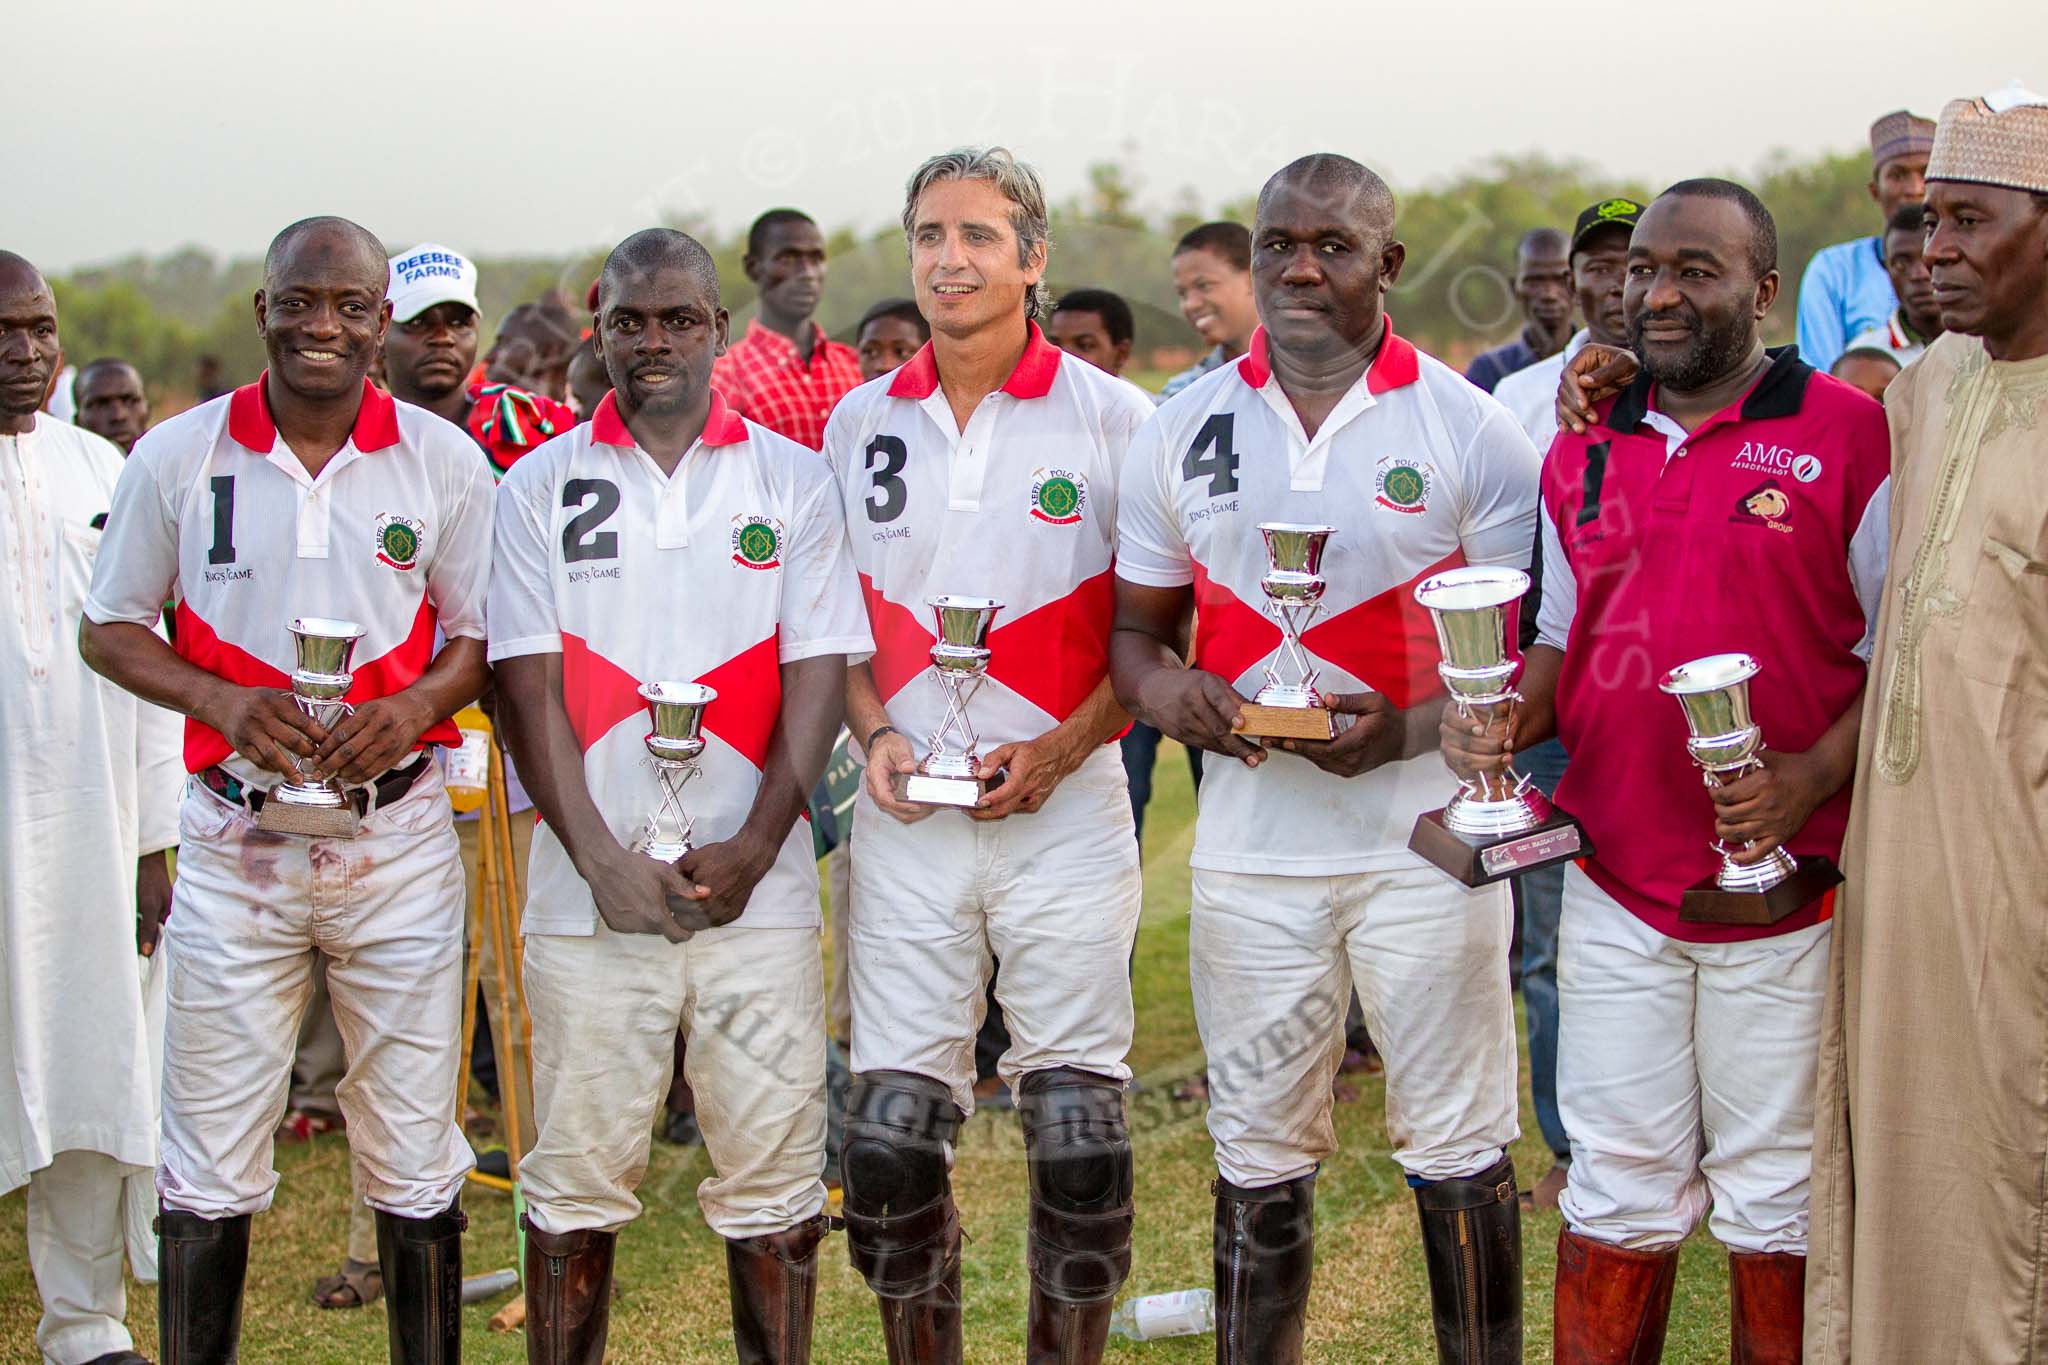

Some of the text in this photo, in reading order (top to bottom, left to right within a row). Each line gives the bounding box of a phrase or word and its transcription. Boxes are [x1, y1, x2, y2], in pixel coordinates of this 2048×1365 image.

[396, 252, 464, 275] DEEBEE
[404, 265, 461, 285] FARMS
[1182, 412, 1239, 498] 4
[1394, 458, 1419, 469] POLO
[1735, 441, 1794, 469] AMG
[865, 434, 907, 523] 3
[1031, 469, 1086, 516] KEFFI POLO RANCH
[1576, 438, 1612, 528] 1
[208, 475, 236, 565] 1
[562, 478, 621, 564] 2
[1212, 500, 1240, 514] GAME
[376, 525, 385, 550] KEFFI
[390, 515, 413, 527] POLO
[731, 515, 783, 561] KEFFI POLO RANCH
[887, 526, 911, 539] GAME
[1767, 520, 1794, 533] GROUP
[227, 568, 254, 580] GAME
[592, 567, 621, 579] GAME
